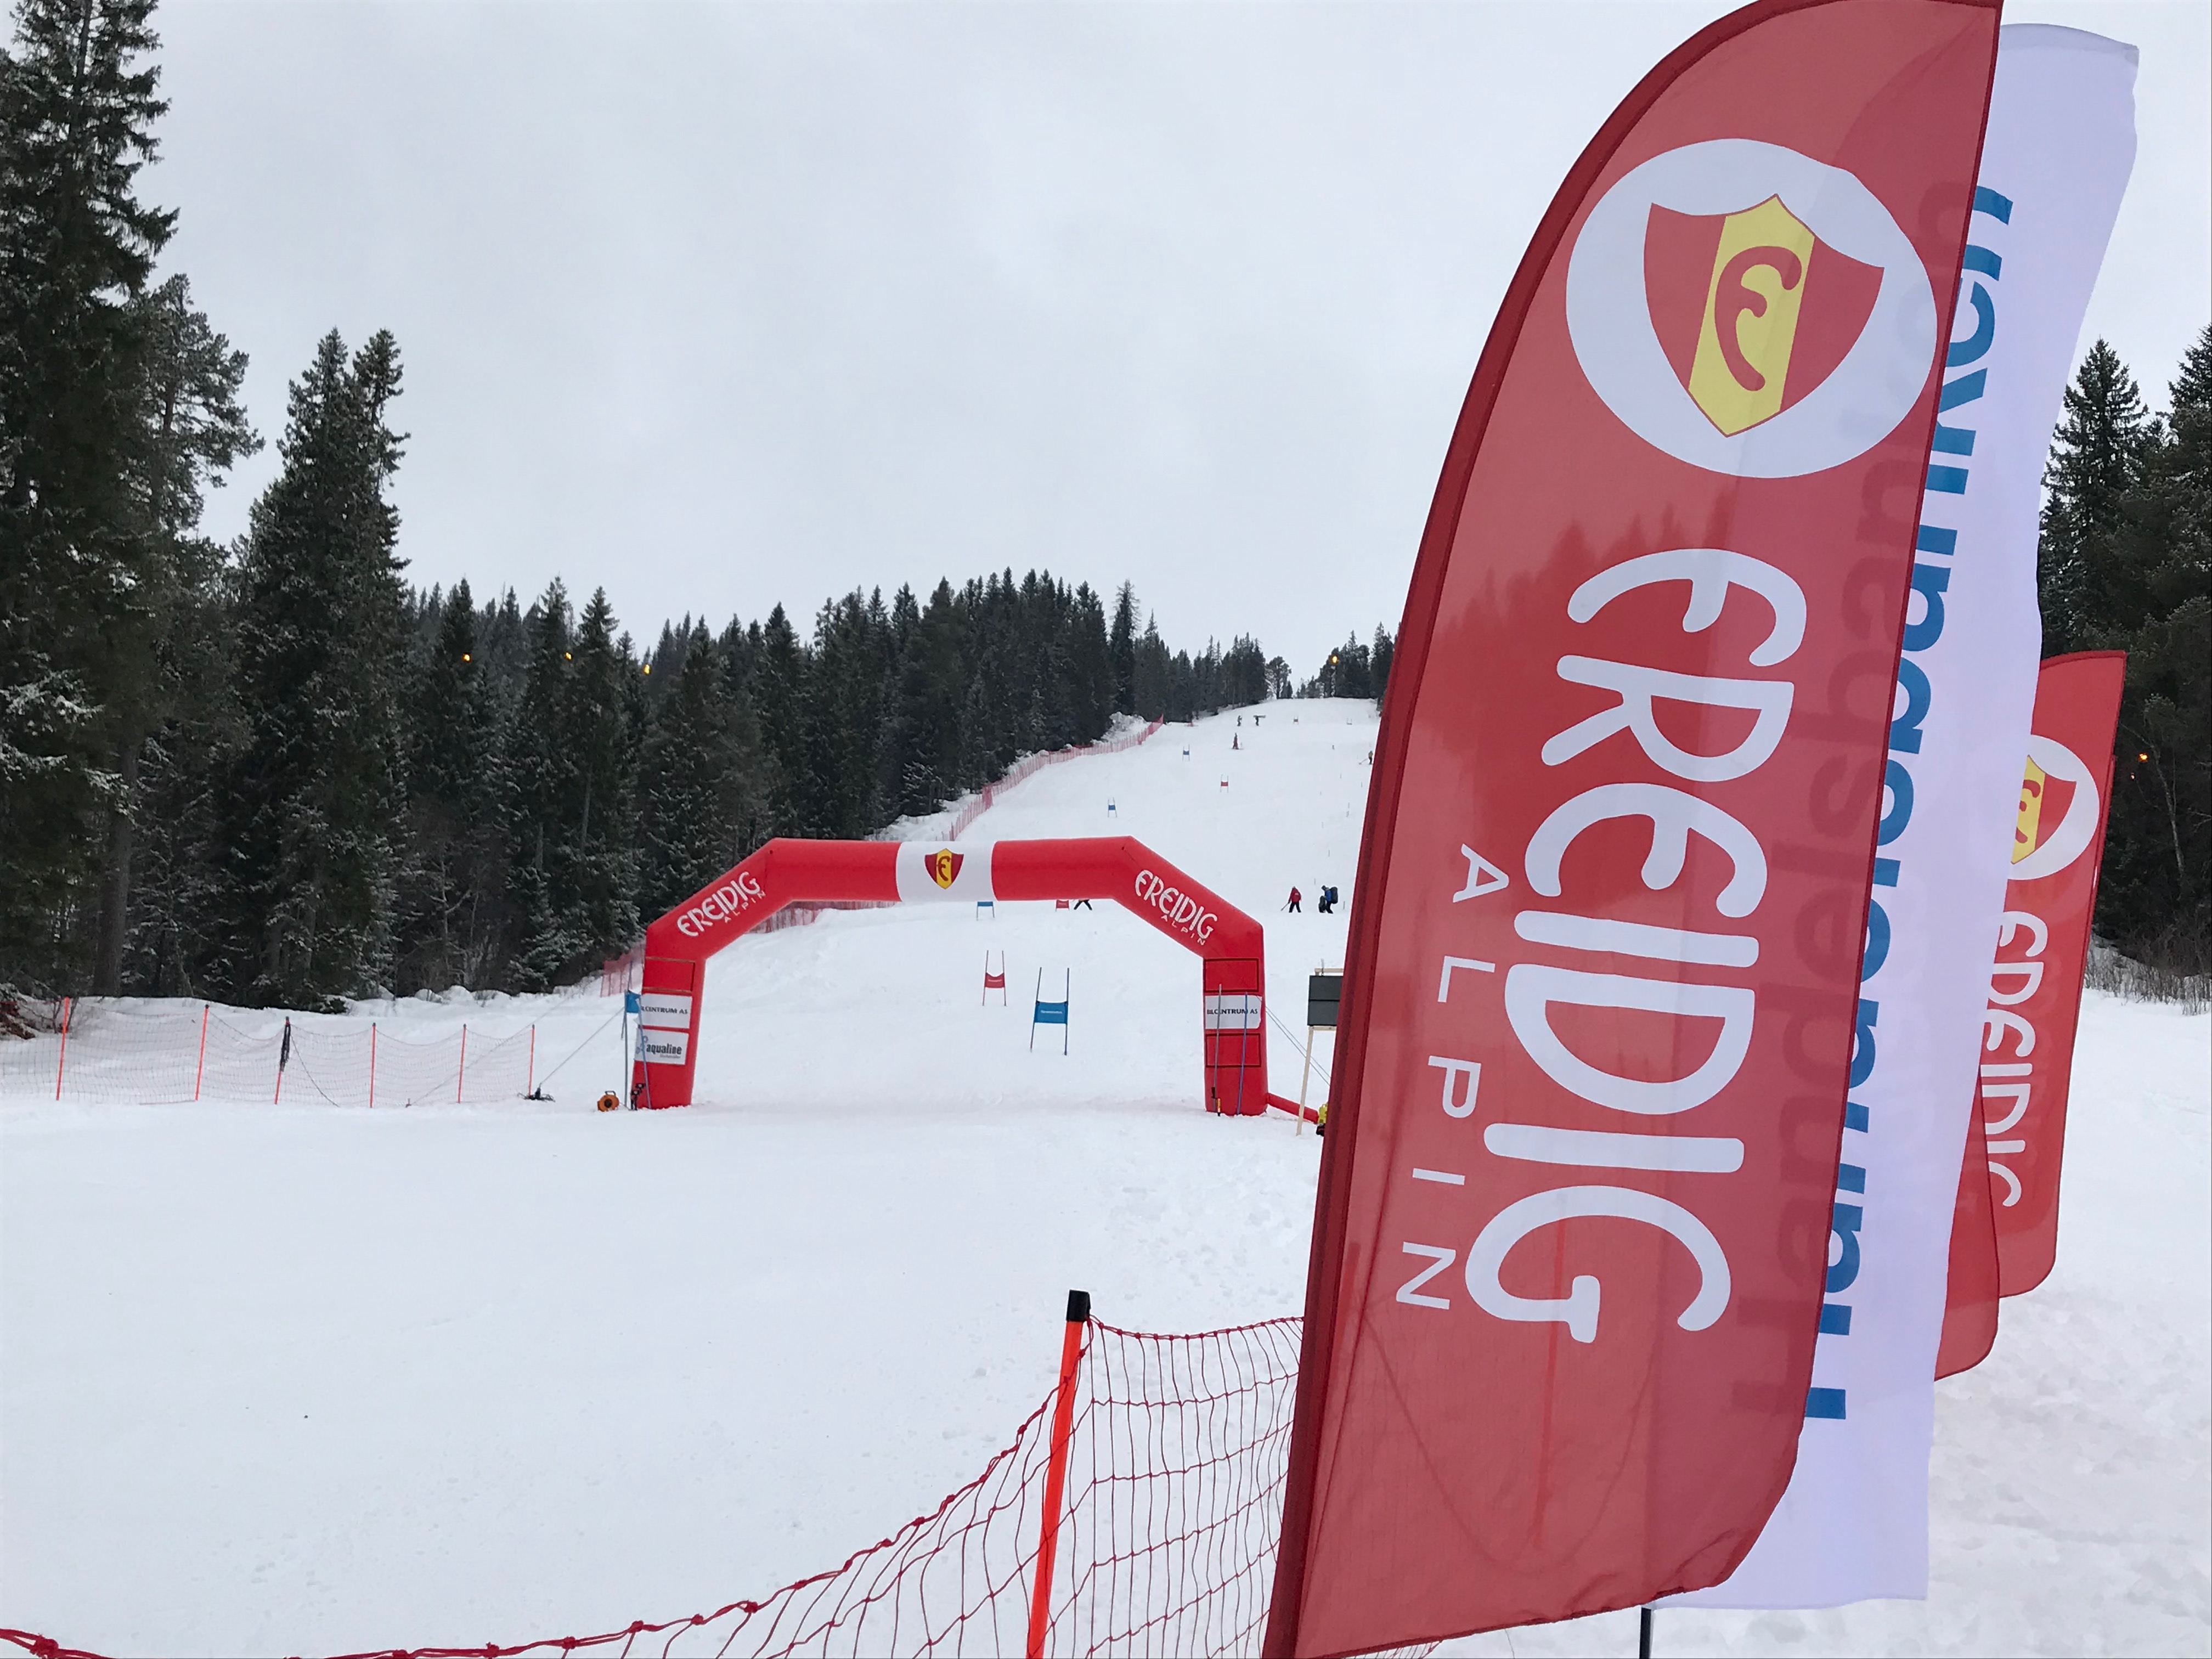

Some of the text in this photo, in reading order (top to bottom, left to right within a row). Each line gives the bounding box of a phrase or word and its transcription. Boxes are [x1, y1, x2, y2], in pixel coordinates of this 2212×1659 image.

[724, 890, 766, 923] ALPIN
[1161, 915, 1206, 946] ALPIN
[1465, 548, 1807, 1344] FREIDIG
[646, 1042, 682, 1055] aqualine
[1396, 843, 1509, 1310] ALPIN
